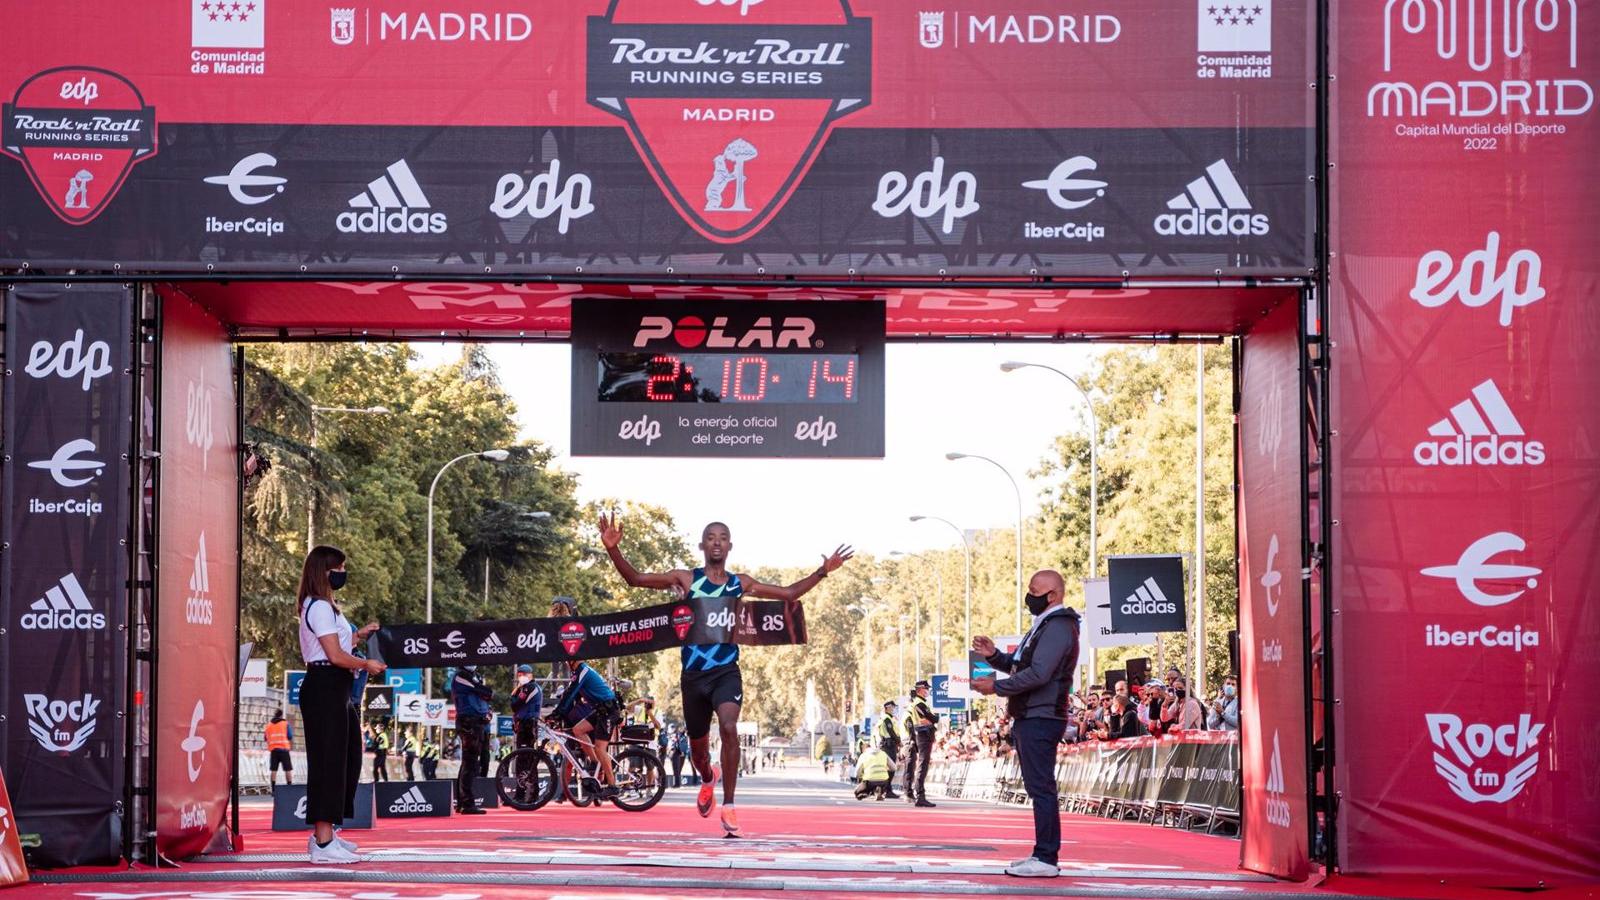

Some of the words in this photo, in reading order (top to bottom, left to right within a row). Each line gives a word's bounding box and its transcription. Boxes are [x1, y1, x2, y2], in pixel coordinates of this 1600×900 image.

[381, 13, 531, 40] MADRID
[970, 15, 1120, 42] MADRID
[192, 51, 264, 61] Comunidad
[1198, 55, 1271, 65] Comunidad
[191, 62, 209, 73] de
[214, 62, 264, 73] Madrid
[630, 71, 734, 84] RUNNING
[742, 72, 822, 84] SERIES
[1198, 67, 1215, 77] de
[1221, 67, 1271, 77] Madrid
[60, 77, 98, 104] edp
[1368, 80, 1593, 116] MADRID
[684, 109, 774, 120] MADRID
[1396, 124, 1439, 137] Capital
[1443, 124, 1490, 134] Mundial
[1493, 123, 1511, 134] del
[1515, 123, 1565, 136] Deporte
[1464, 138, 1496, 149] 2022
[490, 159, 594, 234] edp
[872, 157, 979, 234] edp
[206, 217, 283, 236] iberCaja
[336, 206, 447, 233] adidas
[1154, 207, 1269, 235] adidas
[1025, 222, 1104, 241] iberCaja
[1410, 232, 1545, 326] edp
[633, 317, 816, 348] POLAR
[25, 329, 112, 391] edp
[619, 415, 661, 445] edp
[678, 415, 689, 428] la
[694, 416, 738, 429] energía
[743, 415, 778, 428] oficial
[795, 416, 837, 446] edp
[692, 433, 711, 444] del
[714, 432, 764, 446] deporte
[1414, 433, 1545, 465] adidas
[30, 499, 101, 516] iberCaja
[1121, 599, 1176, 614] adidas
[21, 608, 105, 629] adidas
[590, 622, 628, 636] VUELVE
[629, 621, 637, 631] A
[638, 615, 669, 630] SENTIR
[706, 607, 736, 632] edp
[762, 614, 784, 631] as
[404, 638, 429, 654] as
[516, 629, 547, 653] edp
[608, 630, 653, 646] MADRID
[1426, 625, 1538, 651] iberCaja
[477, 644, 508, 654] adidas
[24, 694, 100, 729] Rock
[54, 728, 70, 741] fm
[1425, 714, 1545, 768] Rock
[1474, 768, 1499, 786] fm
[389, 801, 432, 812] adidas
